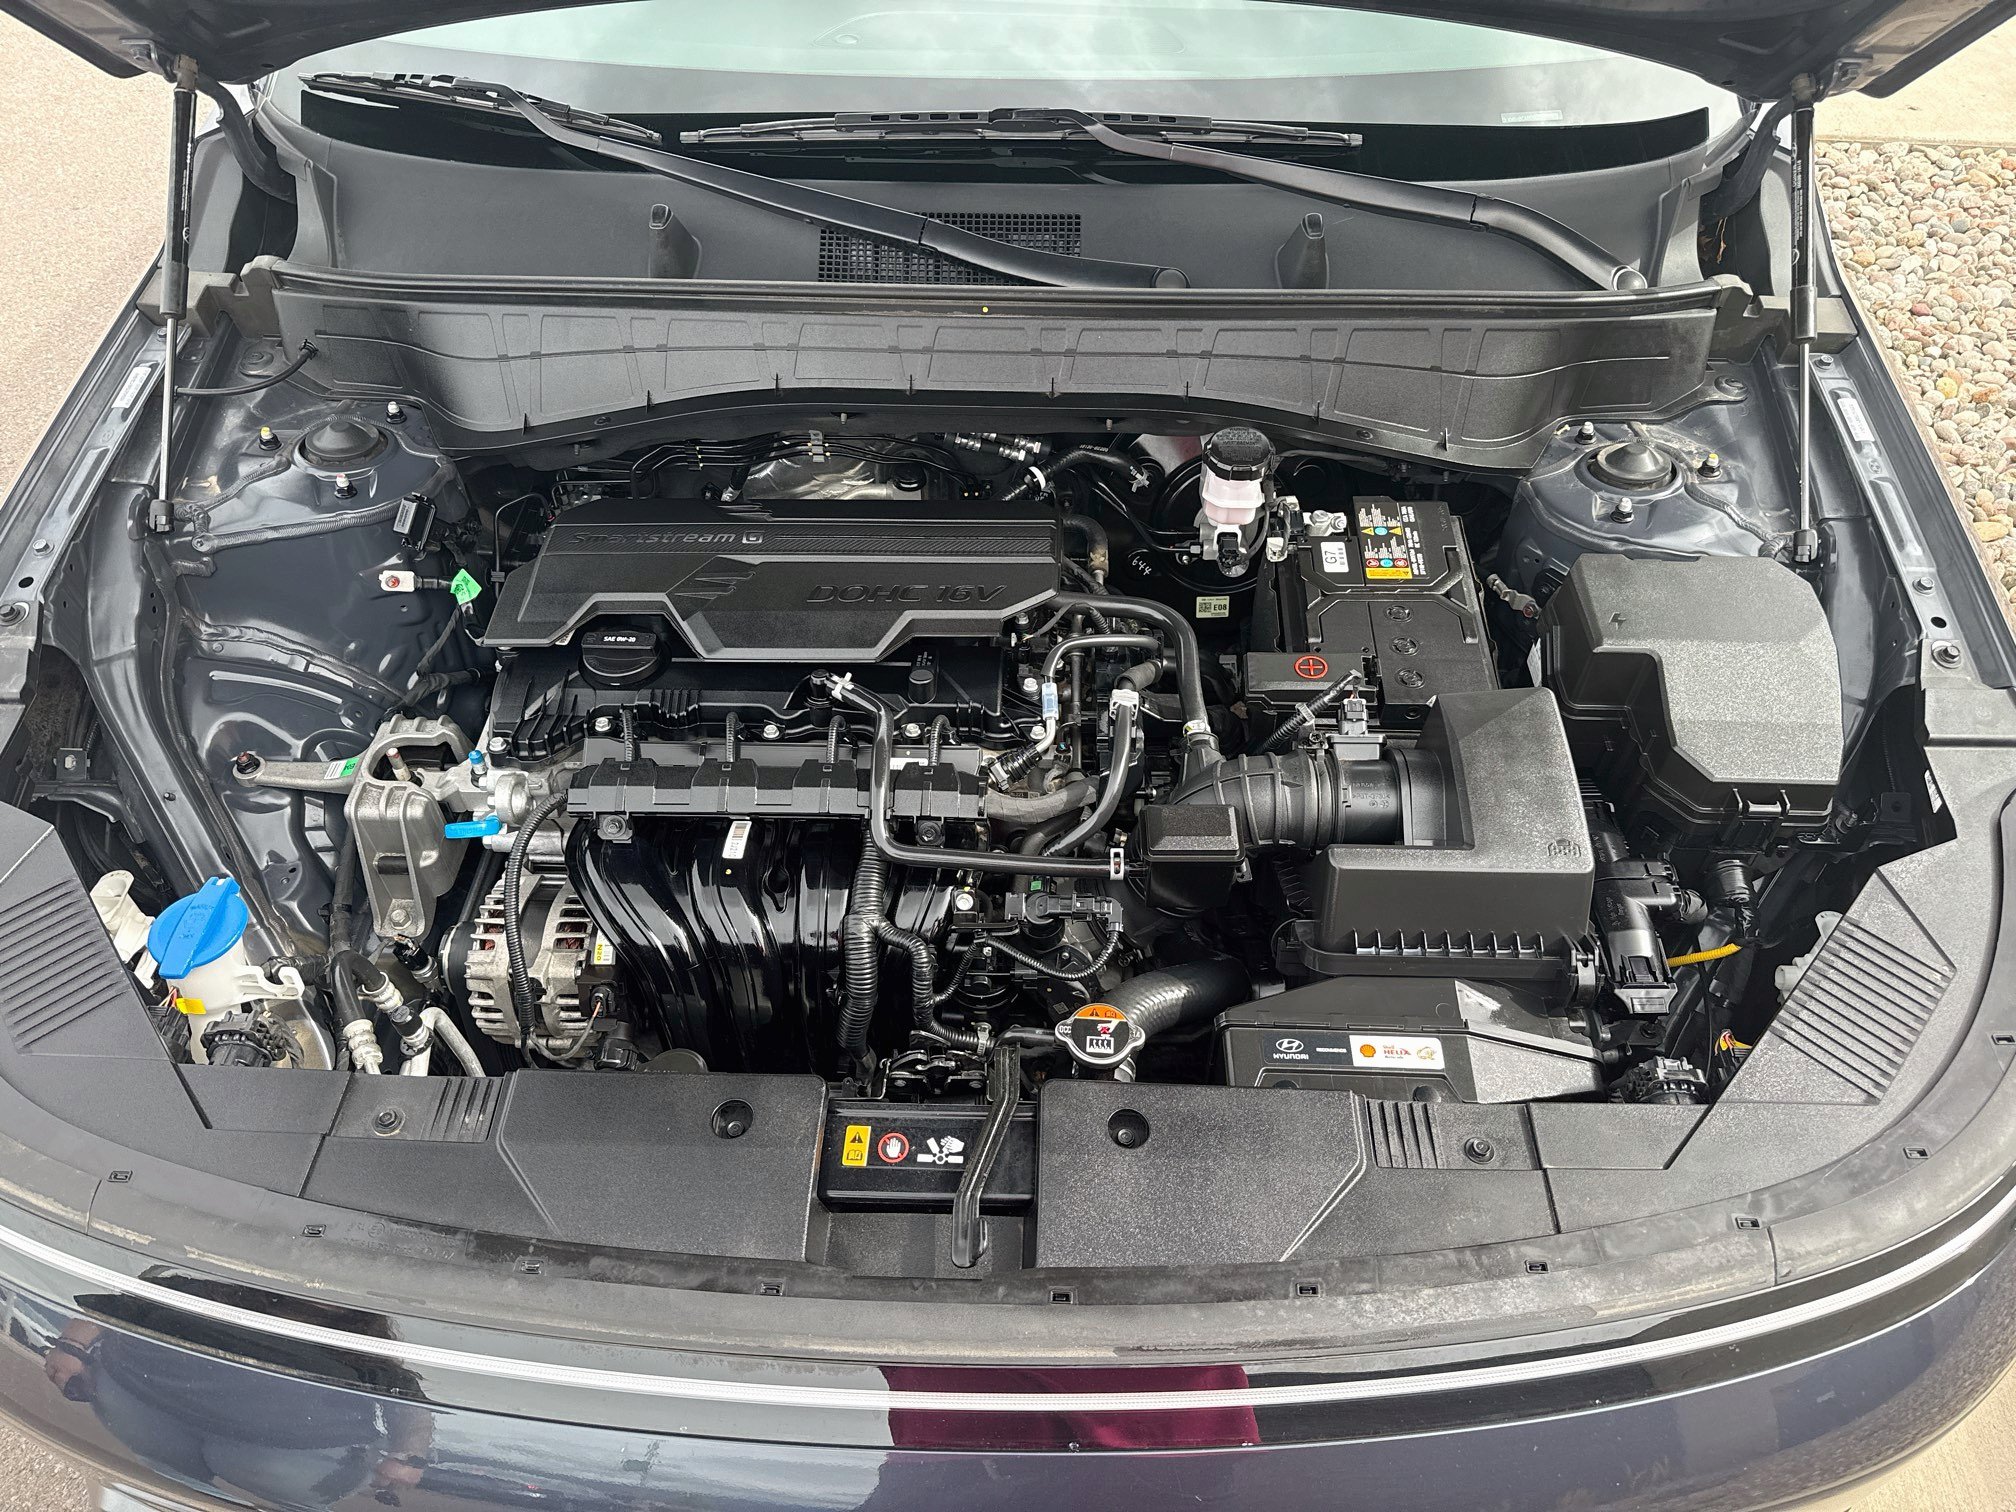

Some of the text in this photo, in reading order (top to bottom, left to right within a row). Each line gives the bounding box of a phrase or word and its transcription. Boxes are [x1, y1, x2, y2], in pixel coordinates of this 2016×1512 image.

[568, 532, 737, 544] Smartstream
[1324, 550, 1338, 564] G7
[1132, 556, 1152, 576] 644
[806, 584, 1008, 603] DOHC 16V
